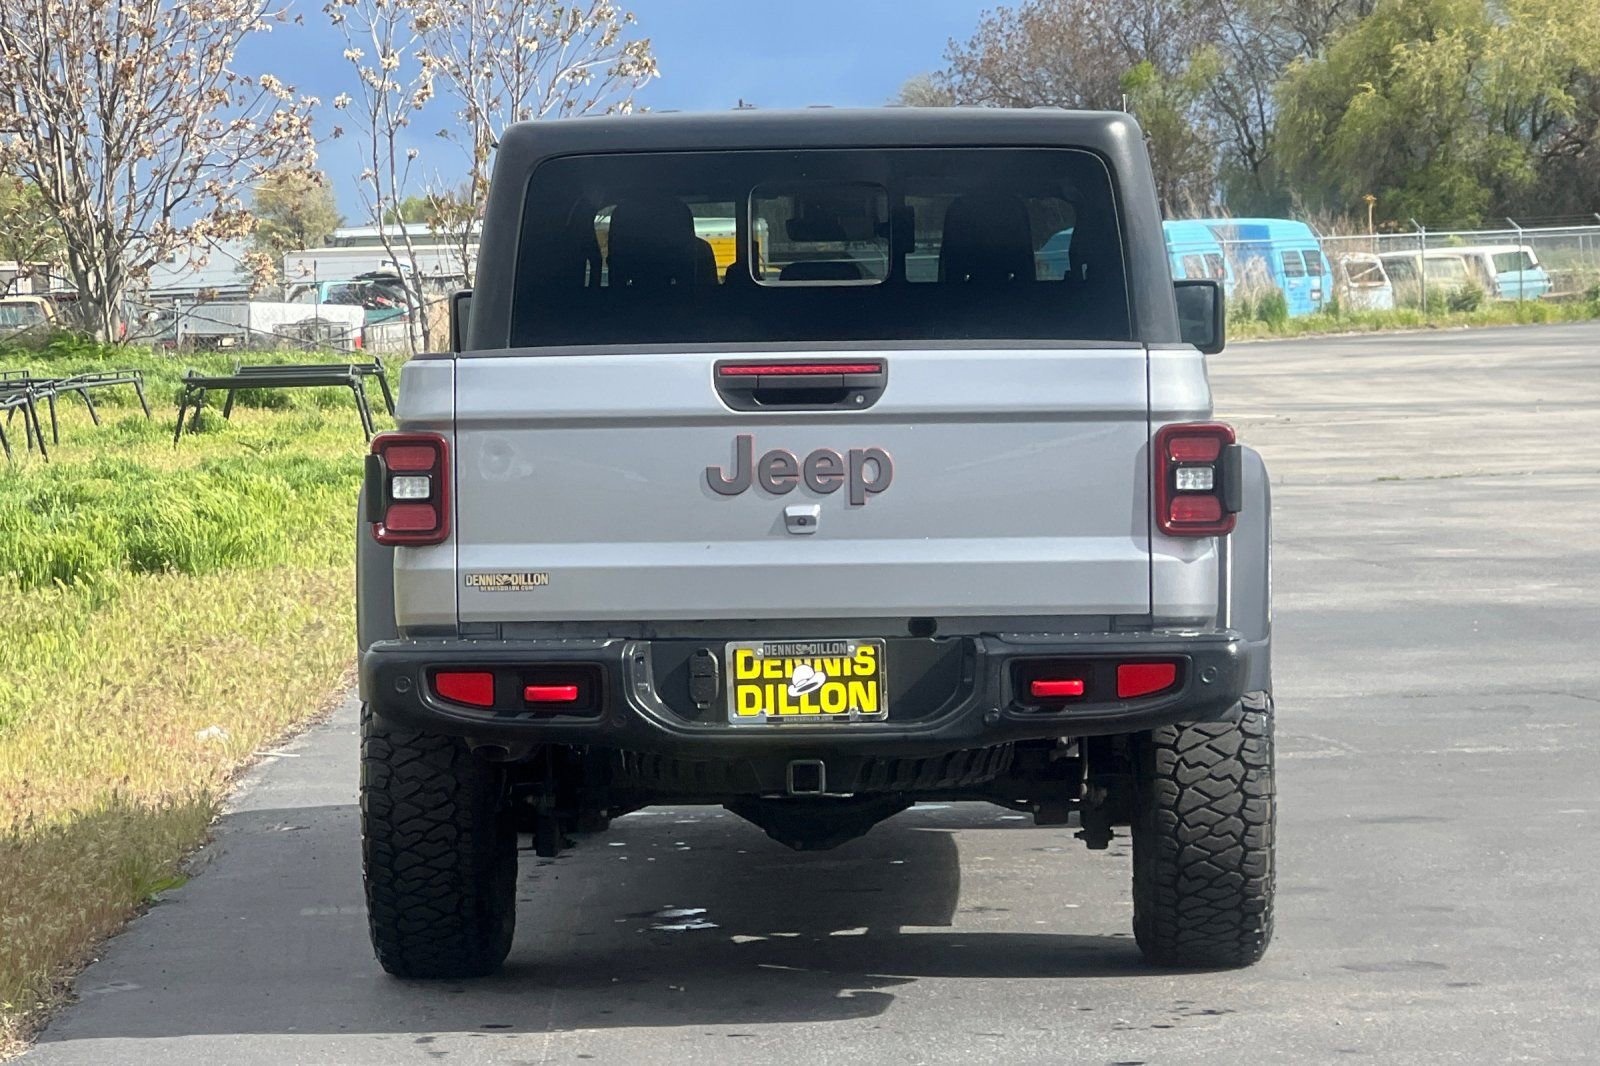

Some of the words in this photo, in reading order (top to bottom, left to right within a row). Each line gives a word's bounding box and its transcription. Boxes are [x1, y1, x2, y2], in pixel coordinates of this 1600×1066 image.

[706, 434, 893, 506] Jeep
[466, 574, 503, 586] DENNIS
[511, 573, 549, 585] DILLON
[764, 643, 803, 656] DENNIS
[810, 642, 847, 655] DILLON
[737, 680, 877, 716] DILLON
